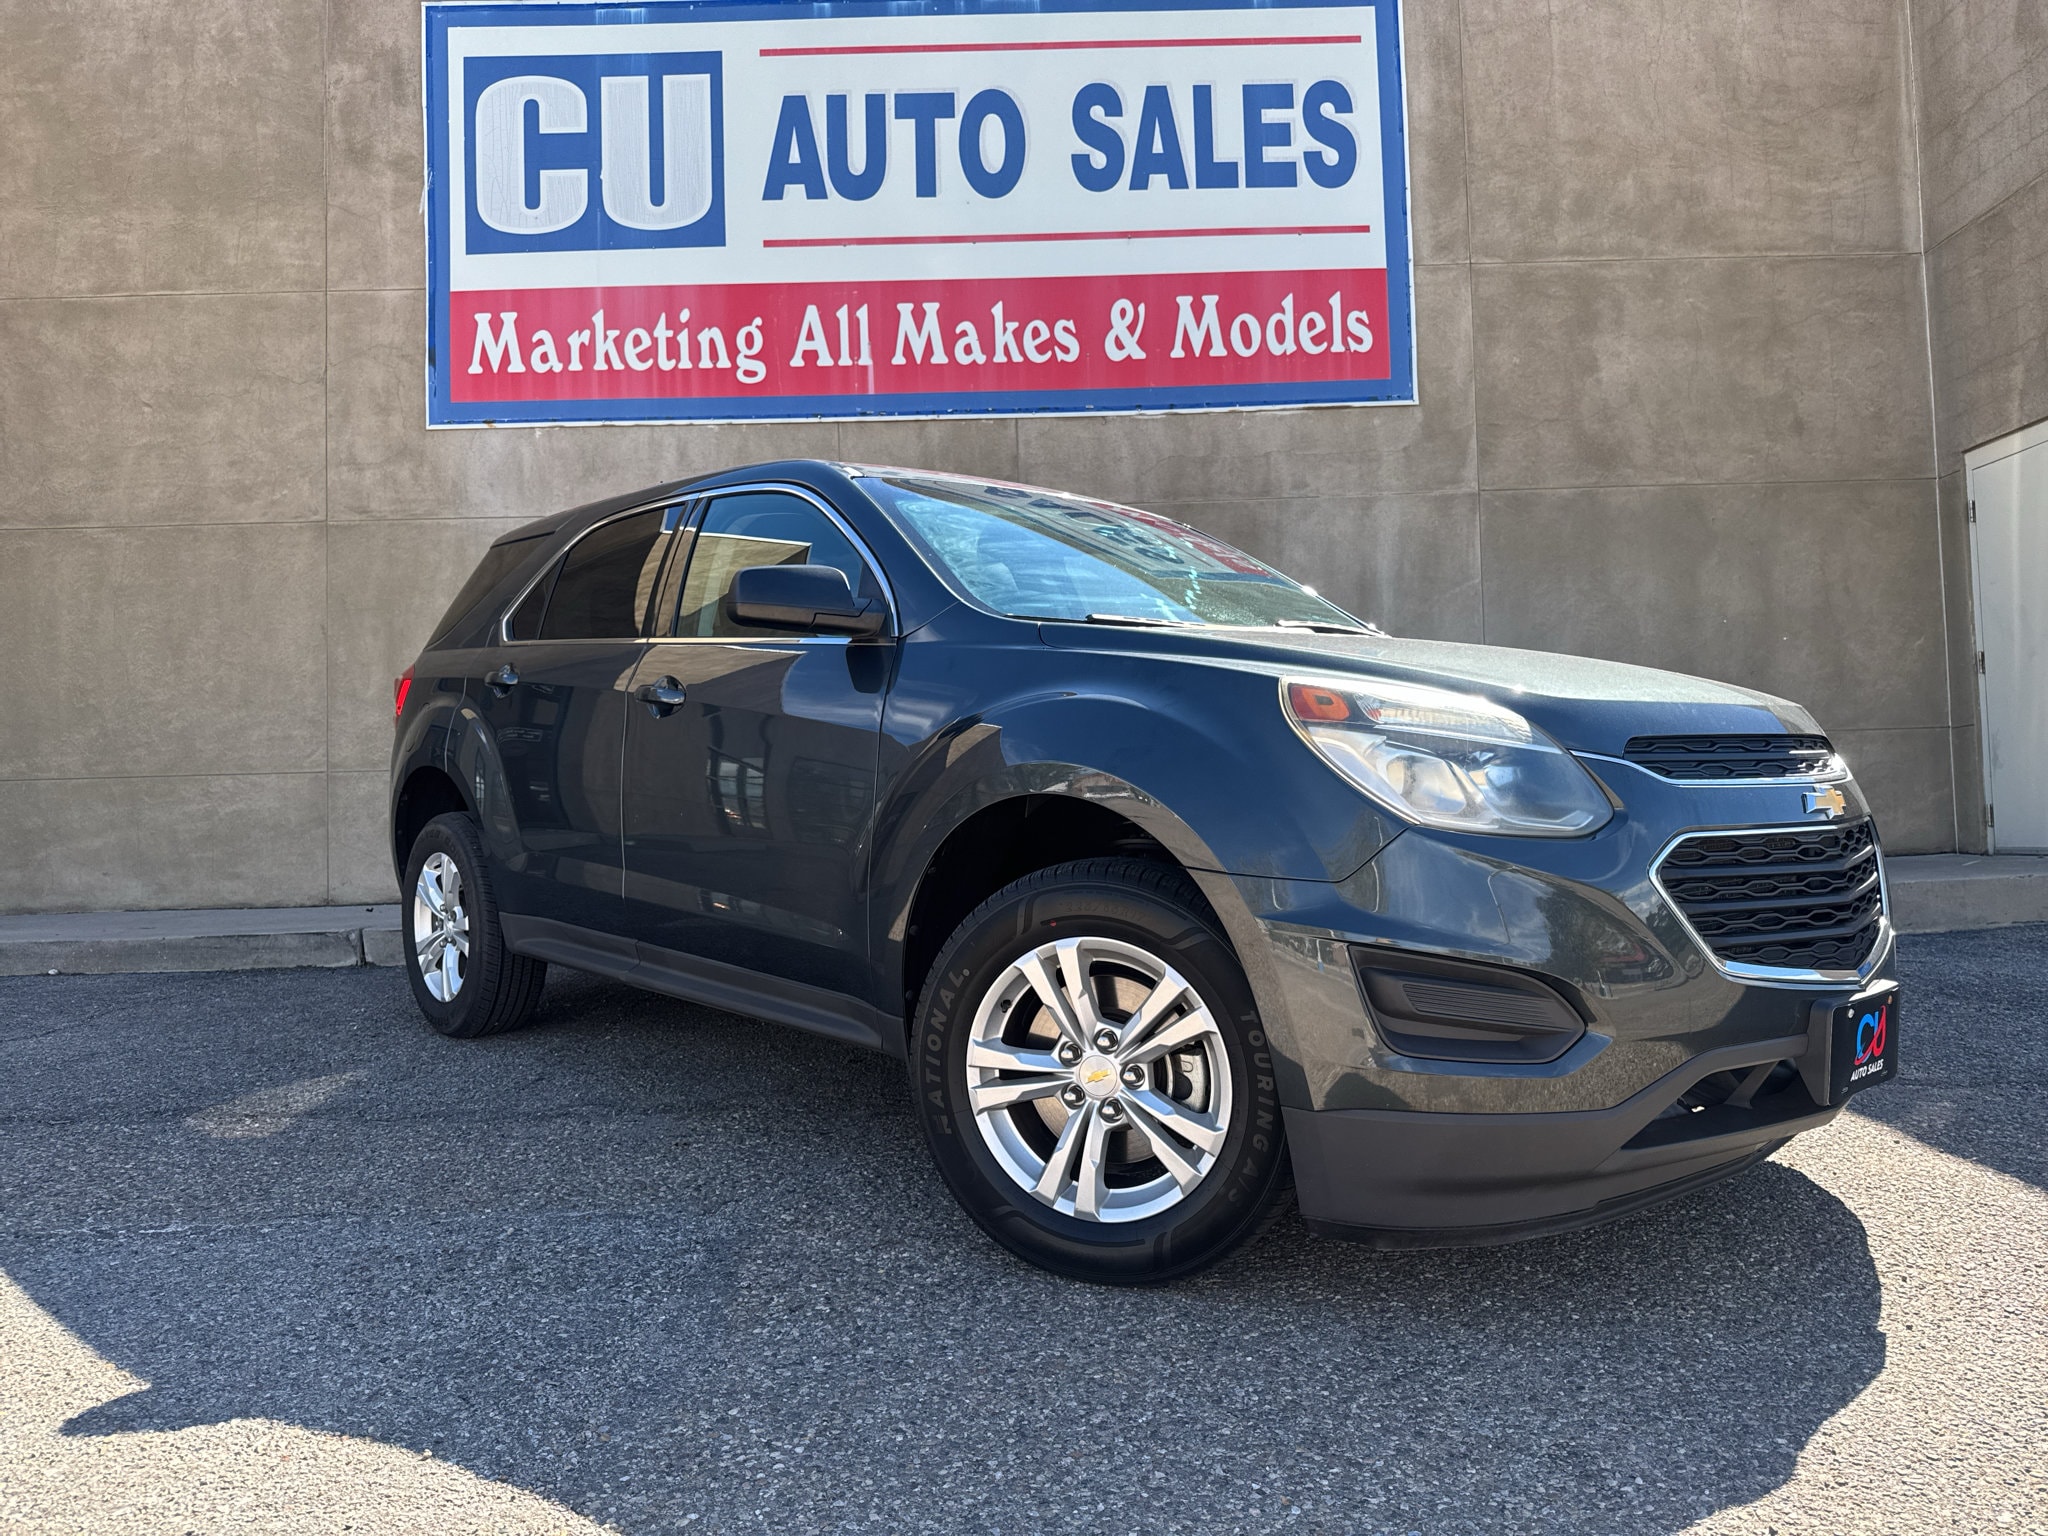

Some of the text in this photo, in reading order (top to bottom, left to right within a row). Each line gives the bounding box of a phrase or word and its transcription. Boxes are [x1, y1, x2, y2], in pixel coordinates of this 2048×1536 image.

[476, 74, 1357, 234] CU AUTO SALES
[468, 291, 1373, 384] Marketing All Makes & Models
[1239, 1009, 1275, 1153] TOURING
[1850, 1058, 1885, 1082] AUTO SALES
